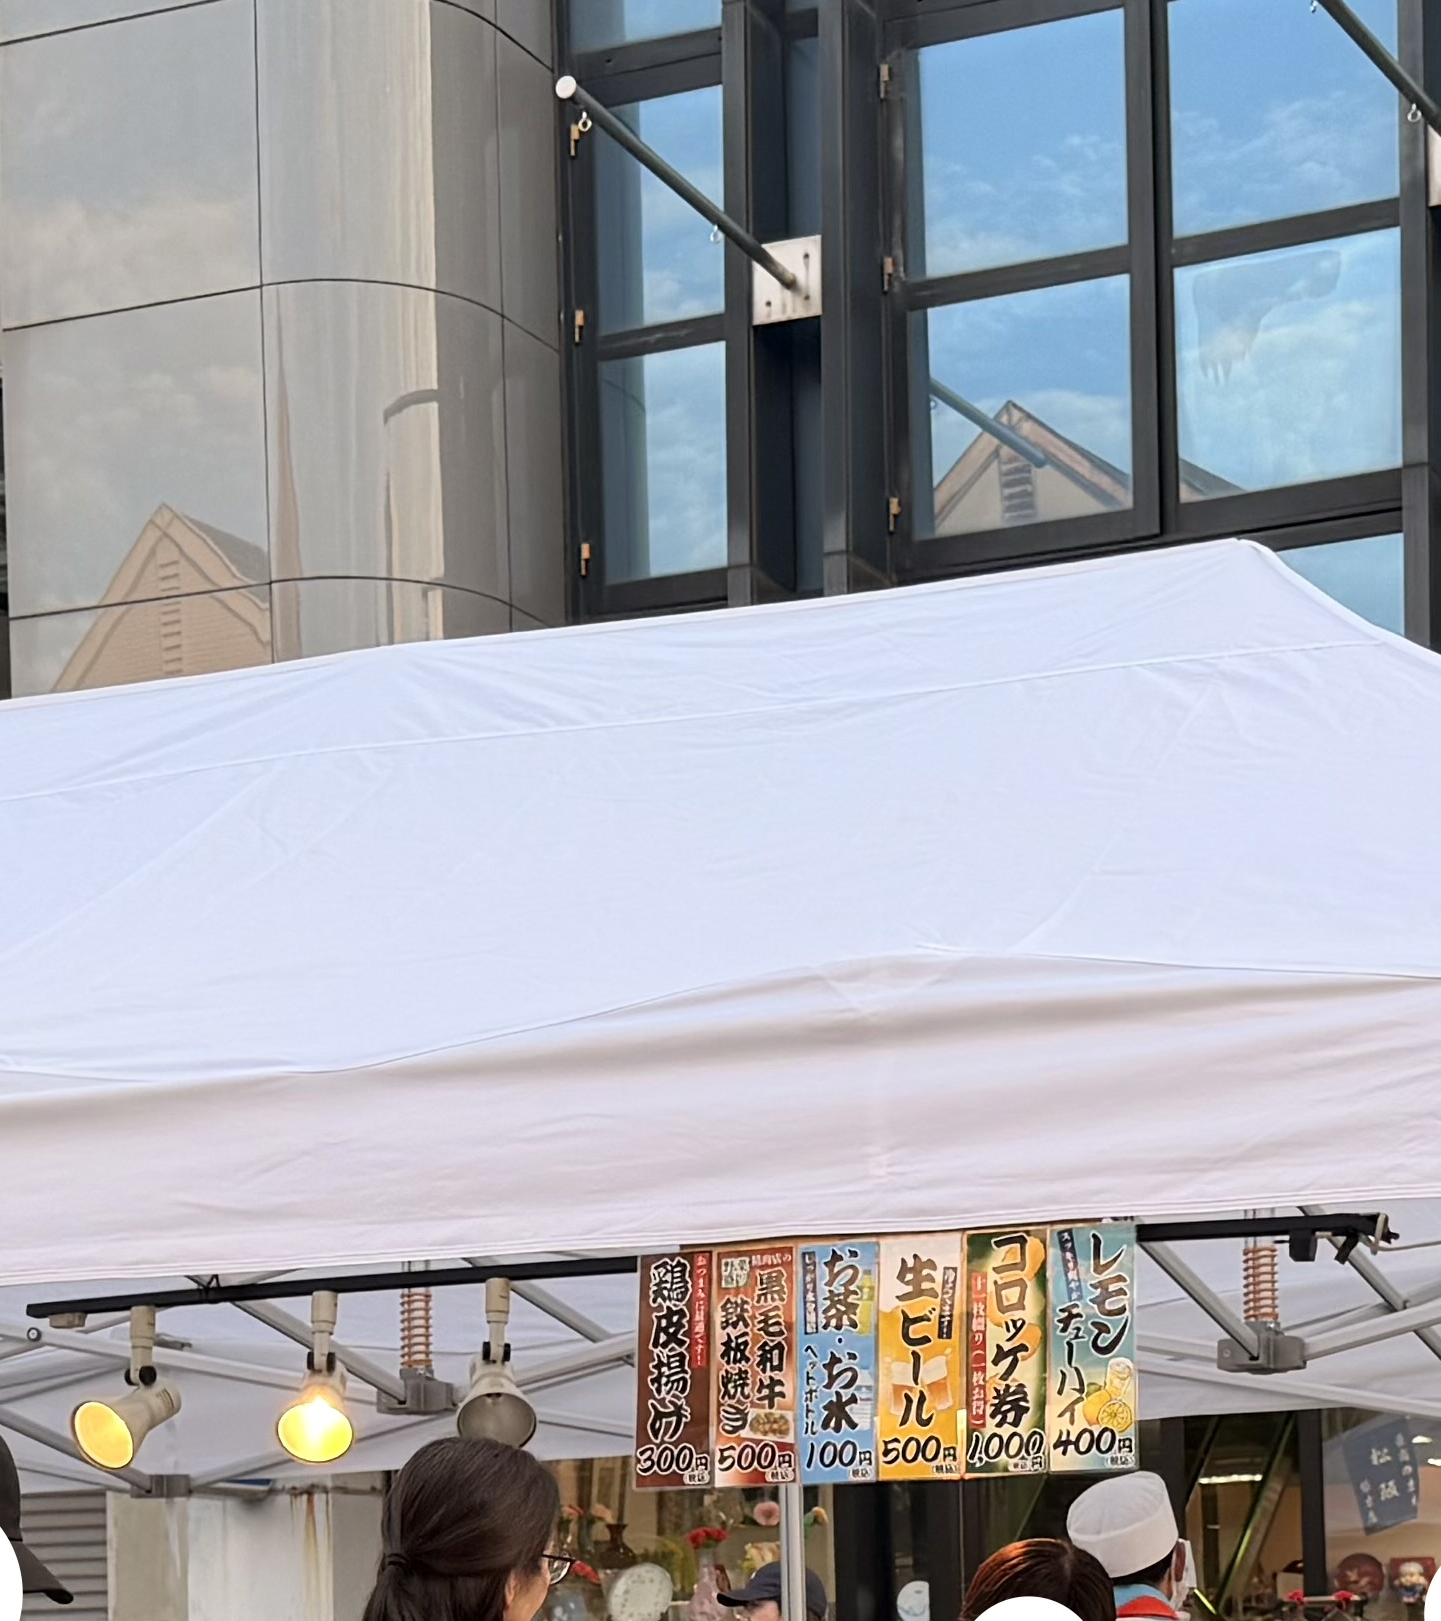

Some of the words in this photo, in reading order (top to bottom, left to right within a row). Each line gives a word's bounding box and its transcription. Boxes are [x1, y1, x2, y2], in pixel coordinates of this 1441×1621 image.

[649, 1257, 691, 1443] 鶏皮揚げ
[754, 1269, 787, 1410] 黒毛和牛
[820, 1248, 861, 1434] お茶・お水
[895, 1253, 939, 1428] 生ビール
[989, 1234, 1031, 1430] コロッケ券
[1089, 1231, 1129, 1357] レモン
[719, 1296, 752, 1438] 鉄板焼き
[1055, 1301, 1087, 1427] チューハイ
[637, 1444, 710, 1475] 300円
[717, 1442, 794, 1474] 500円
[804, 1440, 873, 1470] 100円
[881, 1435, 958, 1465] 500円
[1052, 1426, 1133, 1457] 400円
